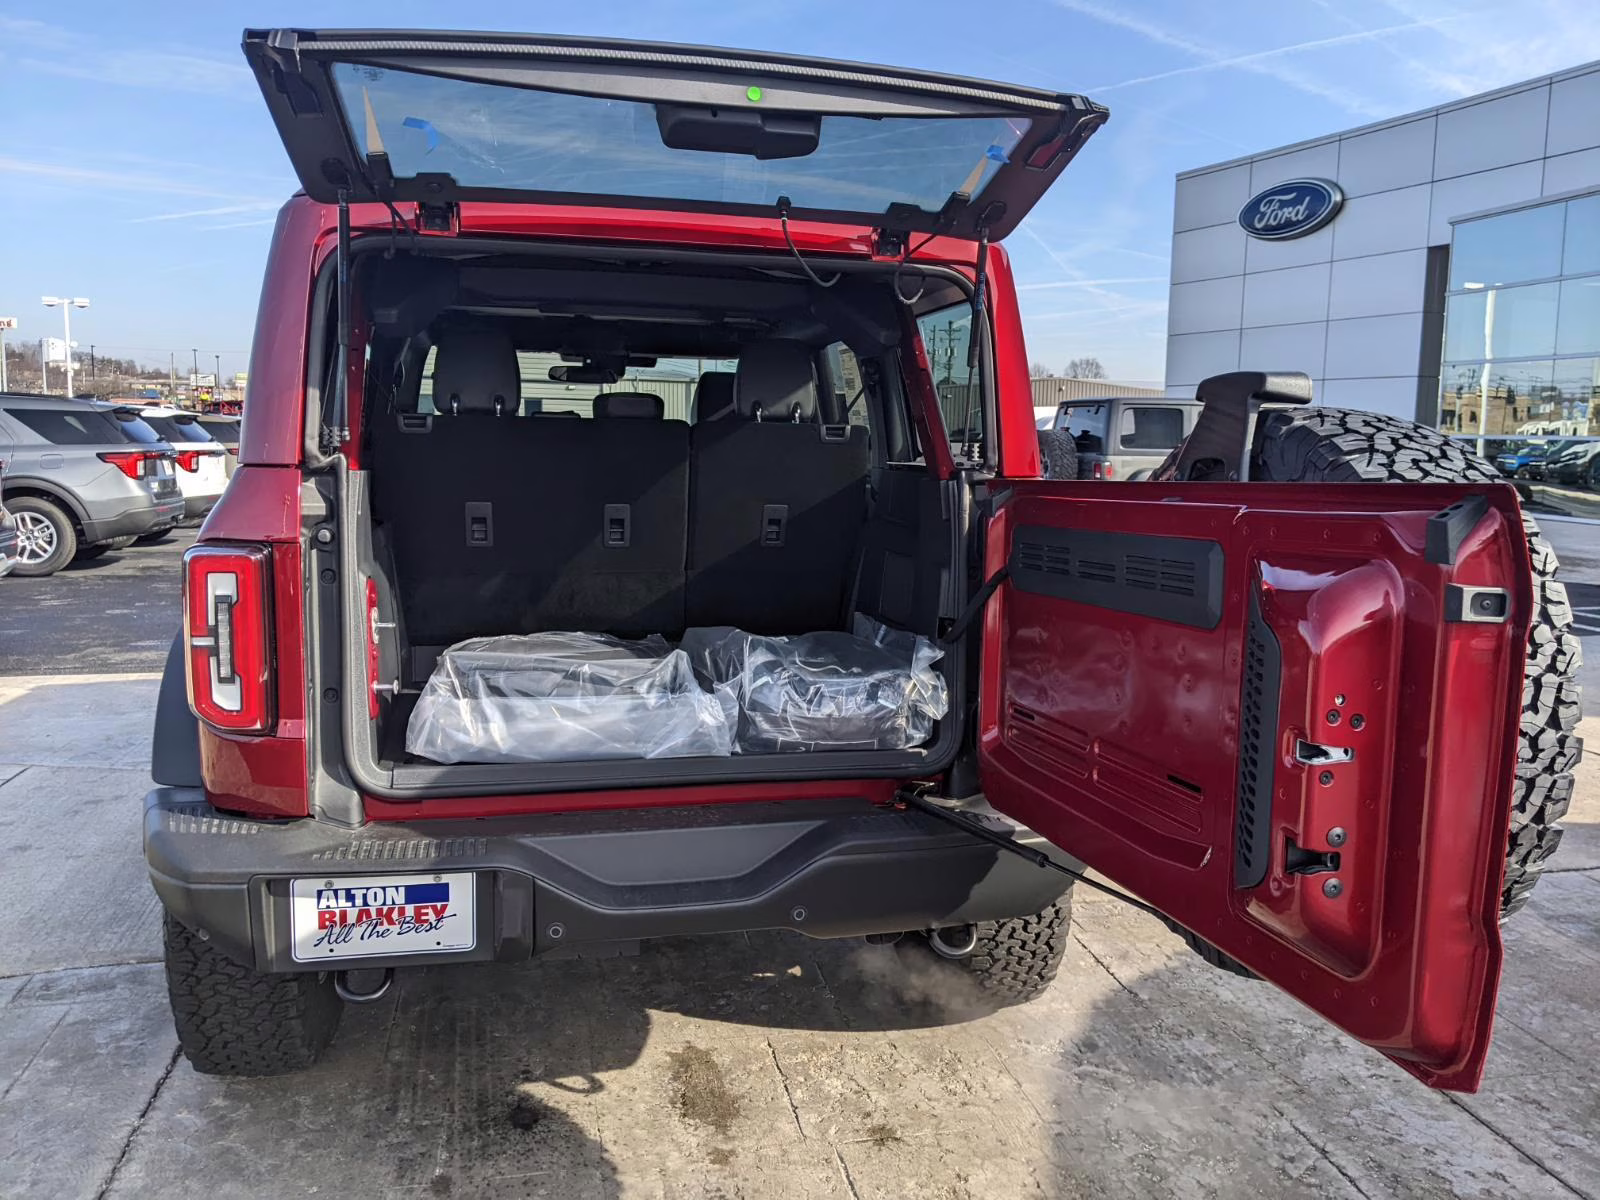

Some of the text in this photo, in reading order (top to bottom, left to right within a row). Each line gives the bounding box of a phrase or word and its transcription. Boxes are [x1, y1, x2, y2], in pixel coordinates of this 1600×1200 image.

[1254, 192, 1311, 229] Ford
[318, 886, 406, 909] ALTON
[313, 913, 457, 947] All The Best
[317, 903, 449, 930] BLAKLEY
